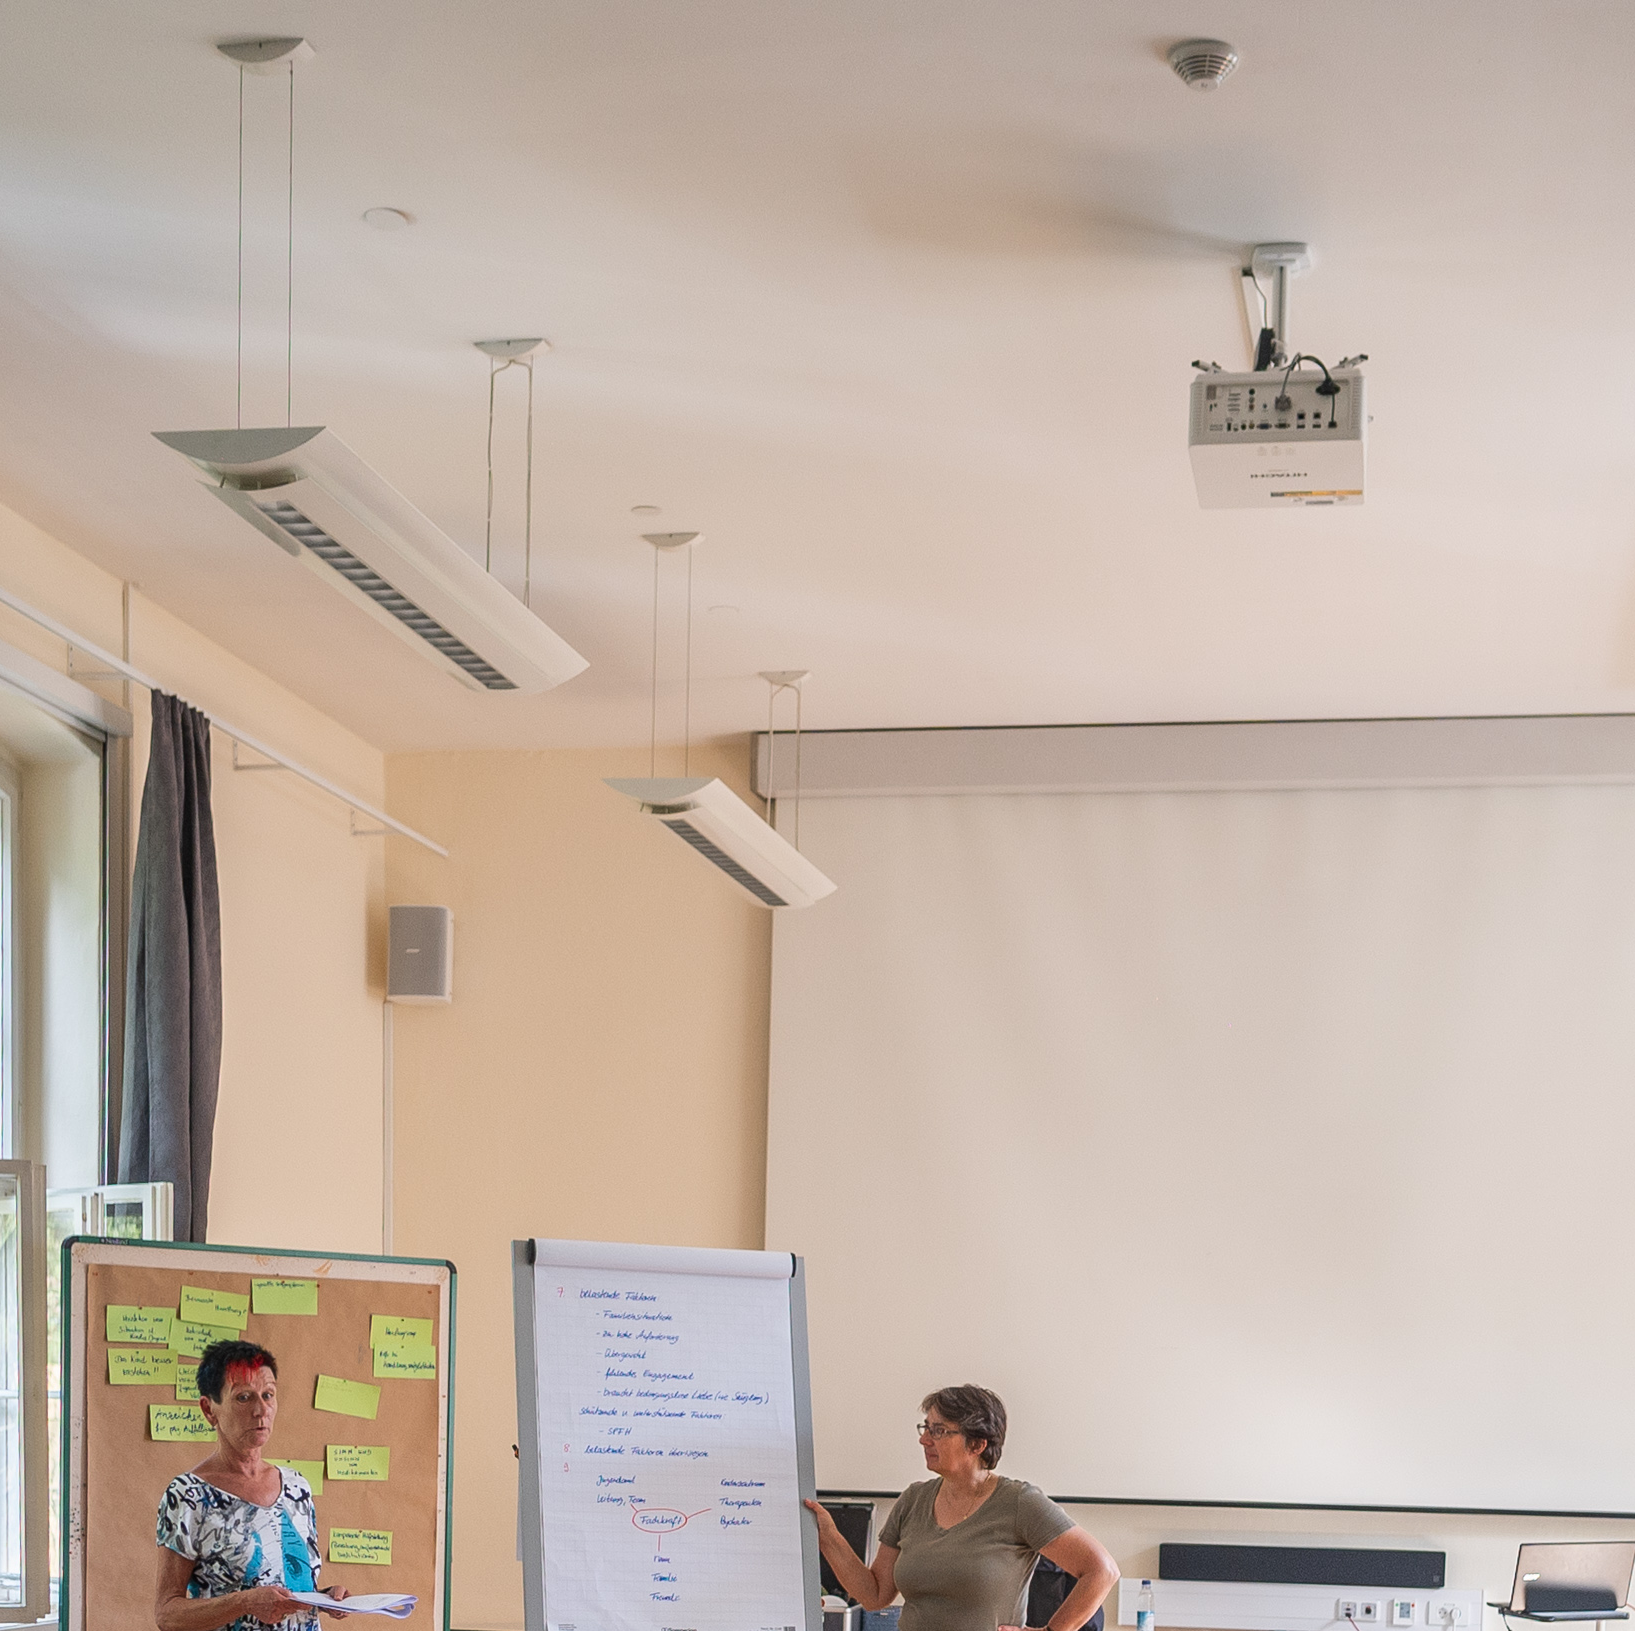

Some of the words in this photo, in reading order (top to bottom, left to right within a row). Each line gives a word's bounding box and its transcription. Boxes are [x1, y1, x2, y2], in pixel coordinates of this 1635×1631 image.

[626, 1291, 657, 1302] Faktoren
[642, 1369, 694, 1382] Engagement
[630, 1446, 664, 1457] Faktoren
[639, 1514, 682, 1527] Fachkraft
